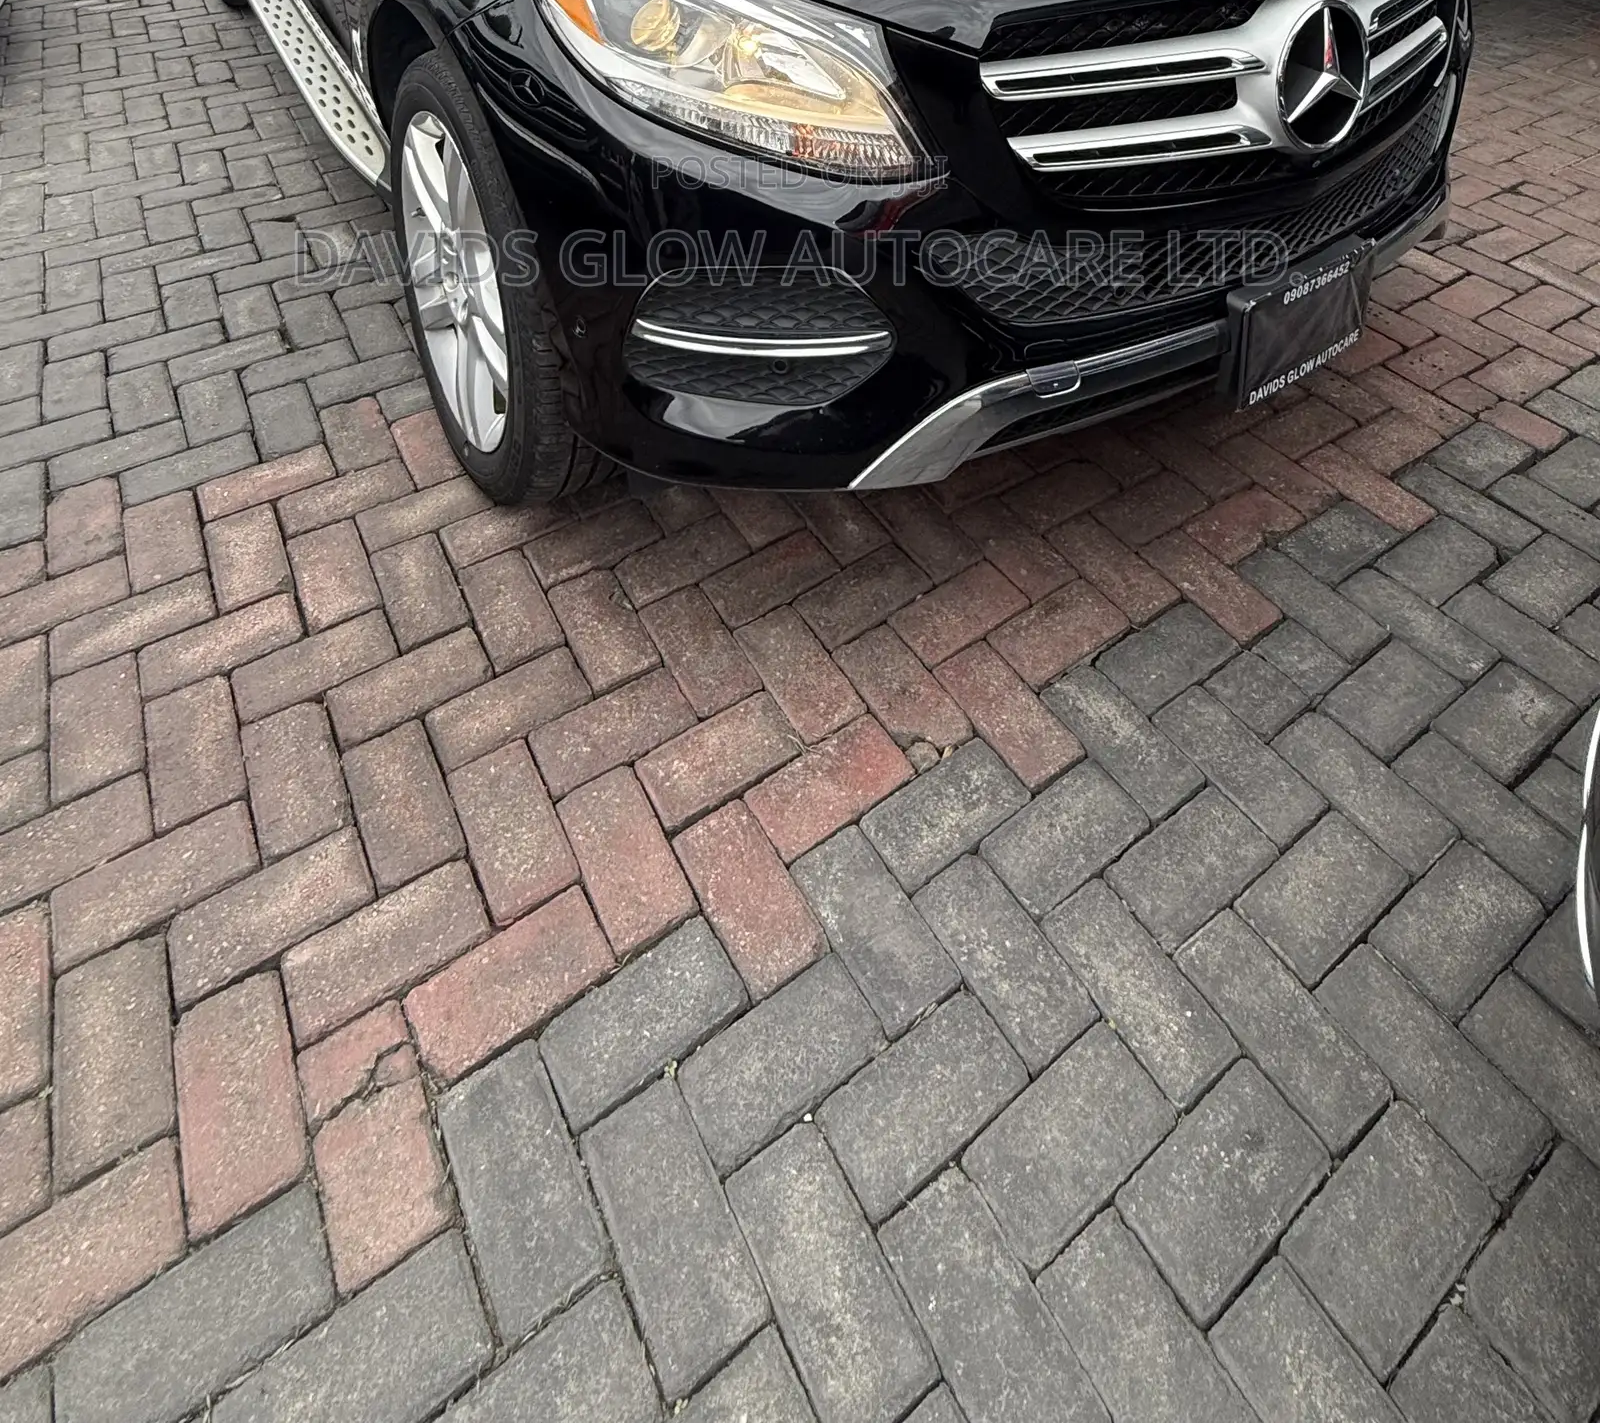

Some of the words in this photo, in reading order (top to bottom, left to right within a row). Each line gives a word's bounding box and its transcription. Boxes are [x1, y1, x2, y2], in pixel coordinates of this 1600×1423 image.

[1283, 261, 1350, 305] 09087366452
[1249, 375, 1286, 405] DAVIDS
[1287, 358, 1316, 384] GLOW
[1315, 329, 1360, 368] AUTOCARE
